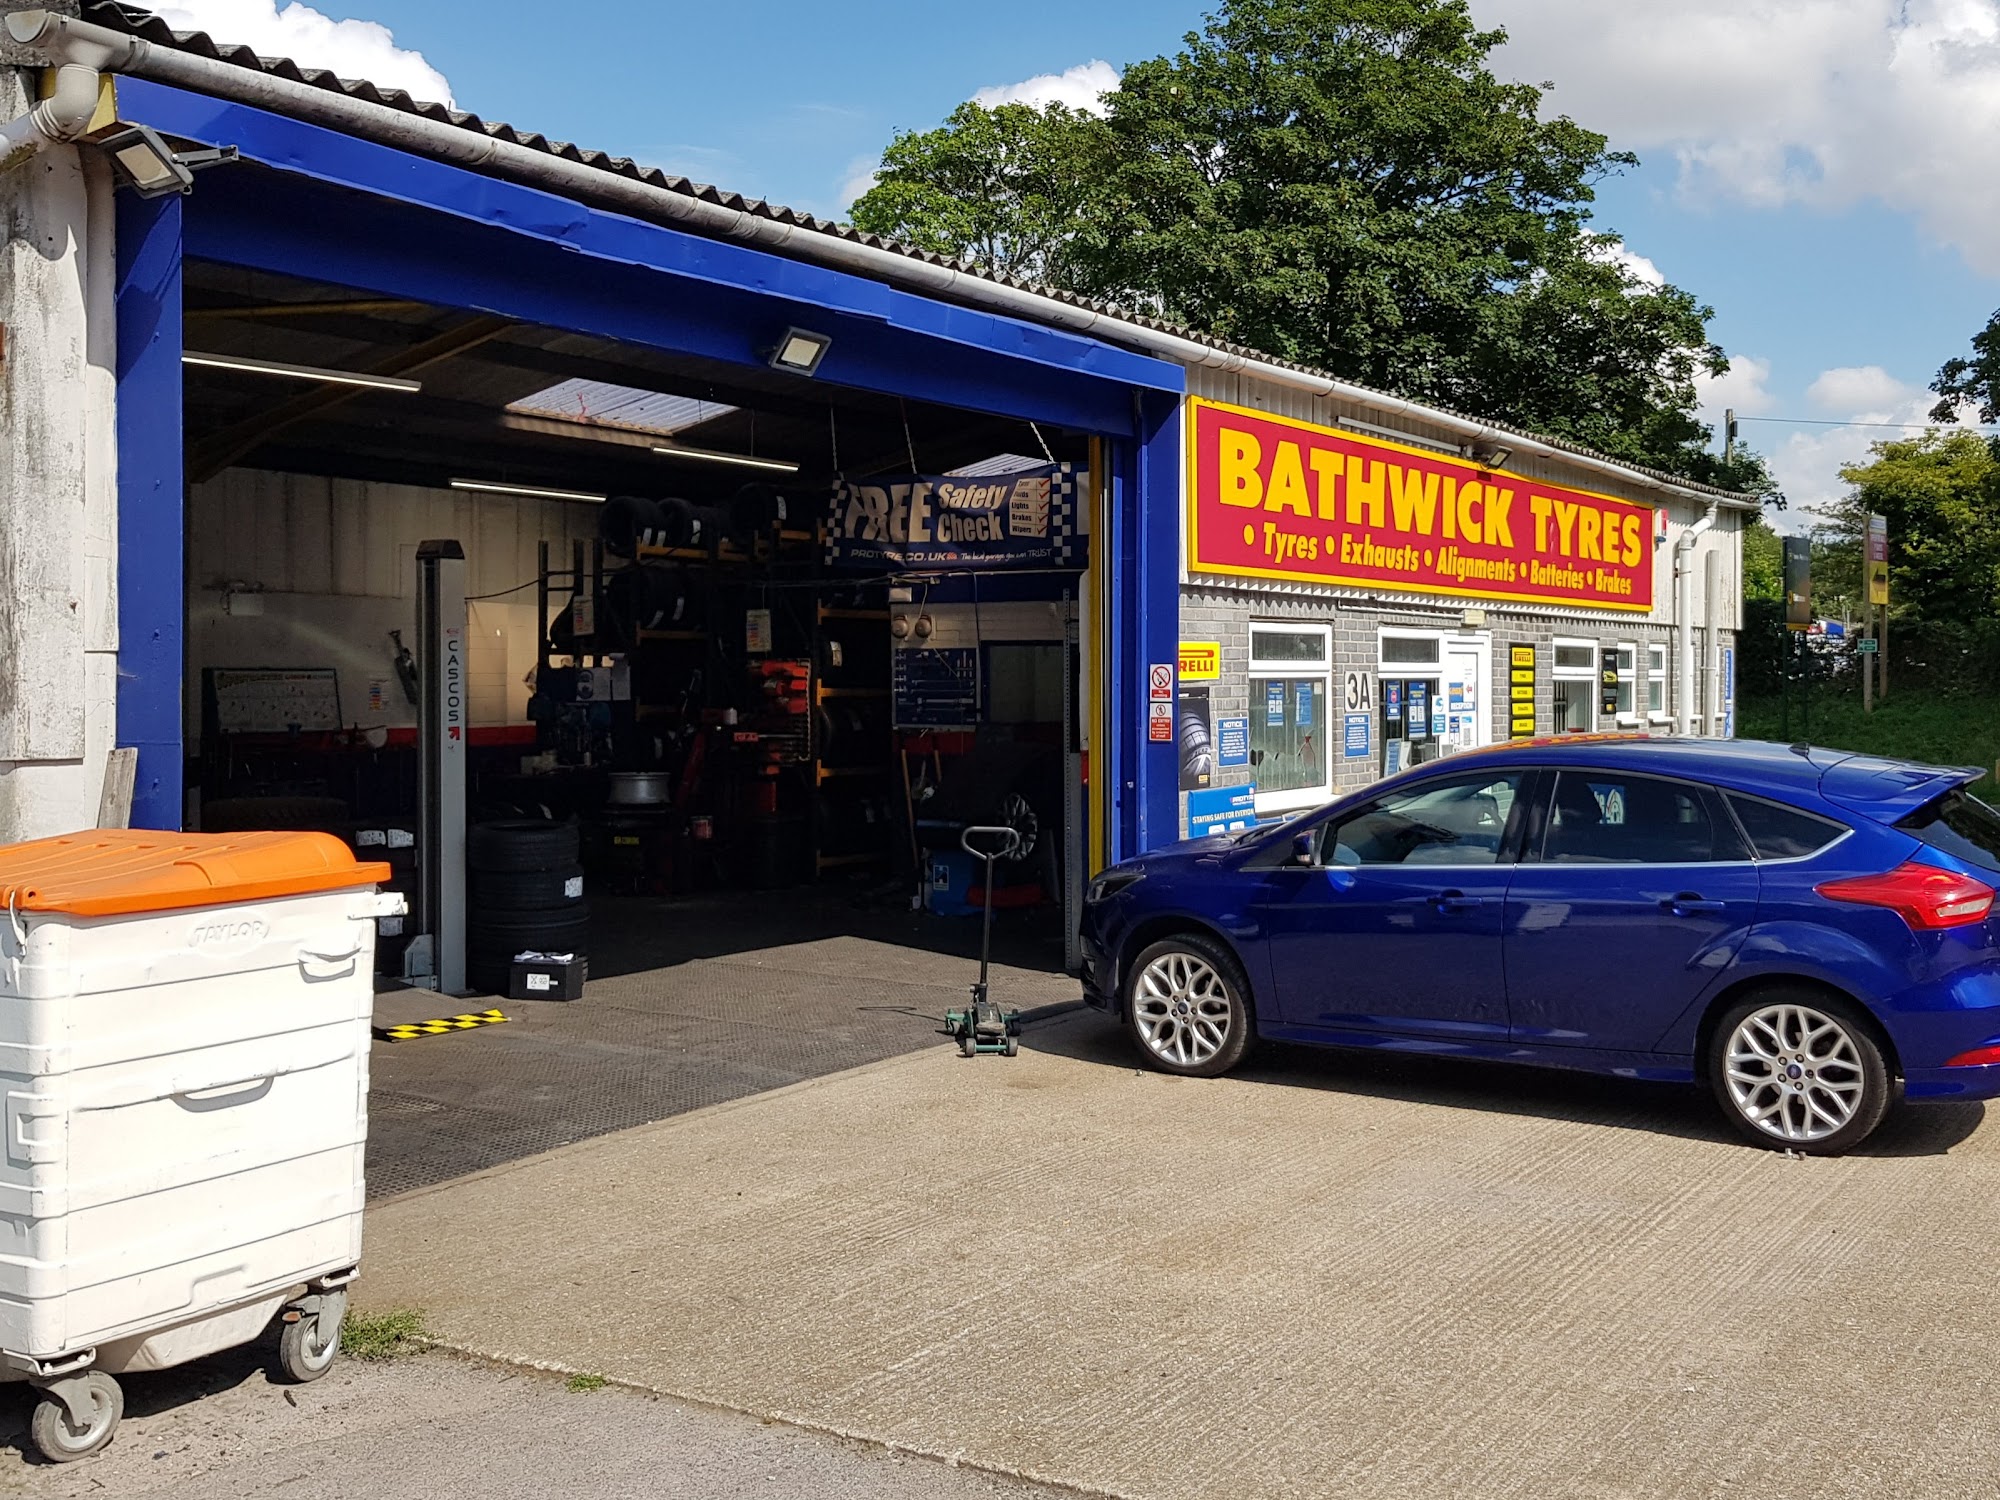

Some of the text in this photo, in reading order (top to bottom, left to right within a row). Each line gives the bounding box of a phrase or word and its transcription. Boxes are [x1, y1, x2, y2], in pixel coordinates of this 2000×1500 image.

[938, 484, 1008, 510] Safety
[1011, 502, 1029, 510] Lights
[1219, 427, 1642, 567] BATHWICK TYRES
[844, 483, 933, 543] FREE
[1011, 513, 1032, 522] Brakes
[937, 511, 1004, 542] Check
[1011, 525, 1032, 534] Wipers
[850, 549, 947, 561] PROTYRE.CO.UK
[1027, 548, 1052, 558] TRUST
[1263, 522, 1632, 595] Tyres Exhausts Alignments Batteries Brakes
[447, 640, 460, 722] CASCOS
[1347, 673, 1371, 710] 3A
[1222, 720, 1243, 728] NOTICE
[1192, 814, 1214, 824] STAYING
[1214, 811, 1226, 821] SAFE
[1225, 810, 1234, 819] FOR
[193, 920, 264, 943] TAYLOR
